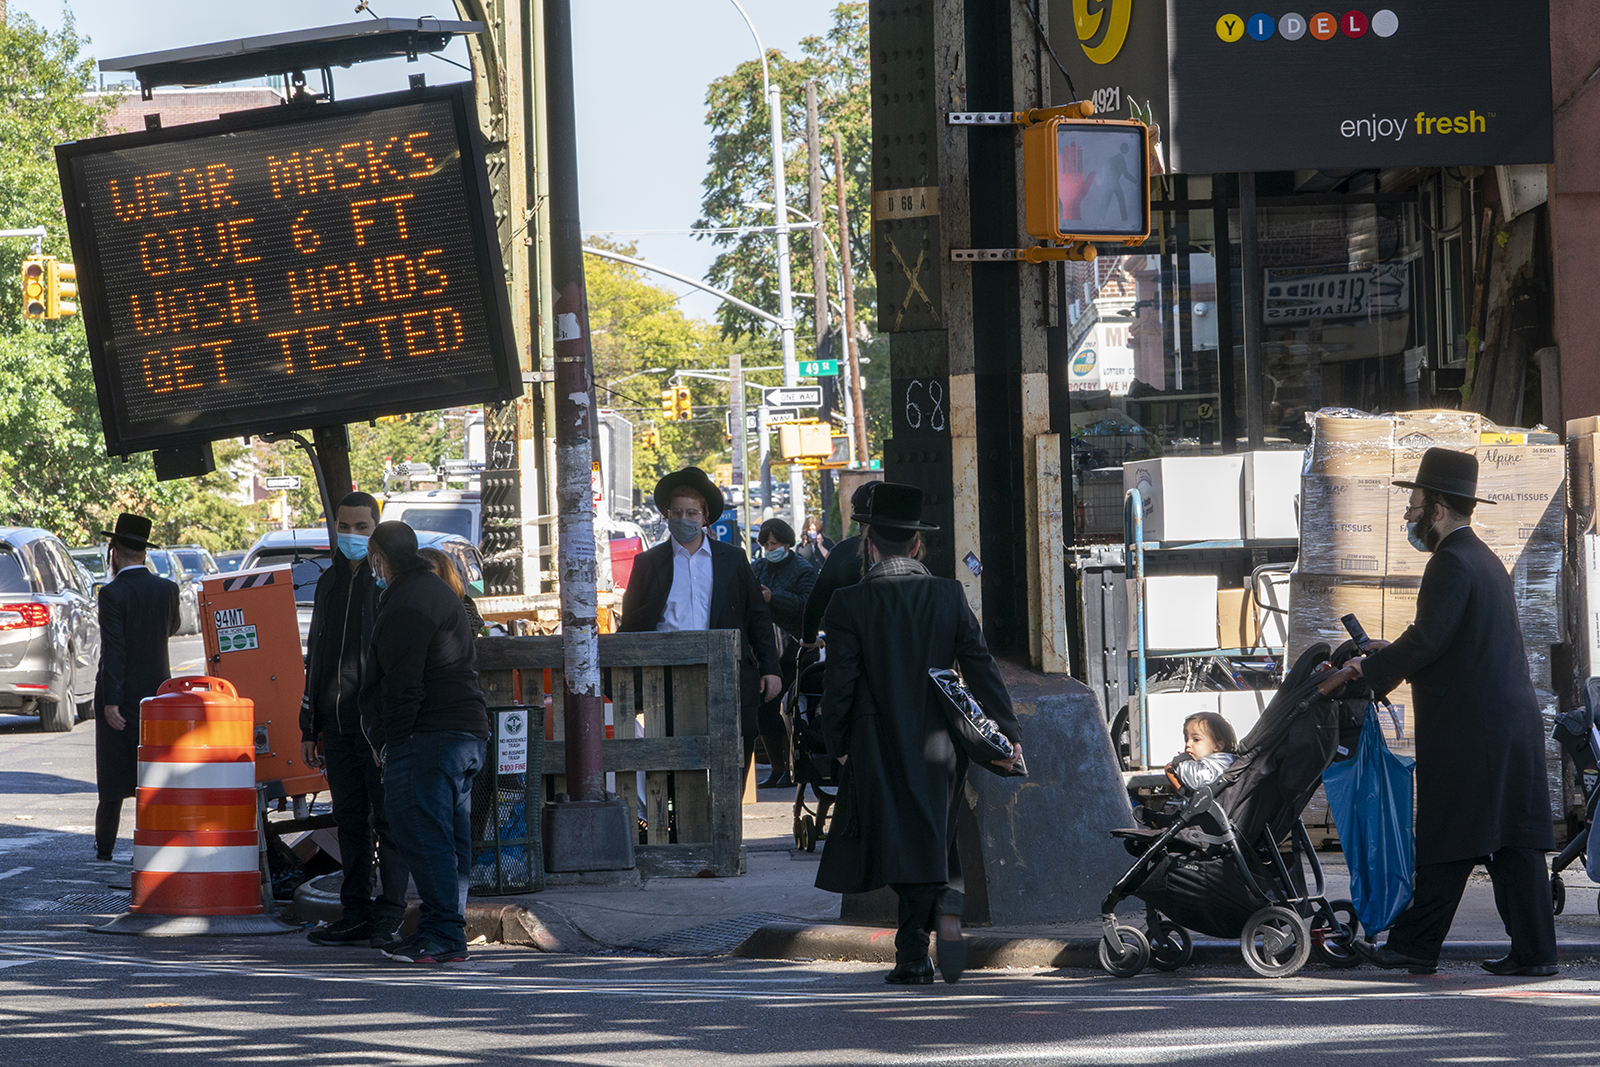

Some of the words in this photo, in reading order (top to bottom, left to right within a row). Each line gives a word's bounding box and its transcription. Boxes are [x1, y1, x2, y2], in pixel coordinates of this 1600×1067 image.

[1091, 86, 1120, 114] 4921
[1340, 113, 1408, 142] enjoy
[1414, 110, 1486, 135] fresh
[110, 163, 239, 222] WEAR
[267, 131, 434, 199] MASKS
[888, 197, 894, 212] D
[901, 195, 913, 211] 68
[920, 194, 926, 210] A
[140, 218, 261, 276] GIVE
[292, 209, 321, 254] 6
[351, 193, 414, 246] FT
[131, 277, 260, 336] WASH
[287, 248, 449, 314] HANDS
[143, 339, 232, 393] GET
[267, 306, 465, 375] TESTED
[805, 362, 819, 375] 49
[1103, 367, 1125, 375] LOTTERY
[1105, 381, 1119, 391] WE
[780, 393, 796, 401] ONE
[905, 379, 945, 432] 68
[492, 439, 514, 469] 67
[1480, 448, 1523, 469] Alpine
[1487, 493, 1516, 501] FACIAL
[1516, 493, 1549, 501] TISSUES
[716, 525, 728, 540] P
[1340, 523, 1373, 533] TISSUES
[214, 608, 243, 628] 94MT
[219, 632, 256, 651] DOT
[499, 764, 514, 772] $100
